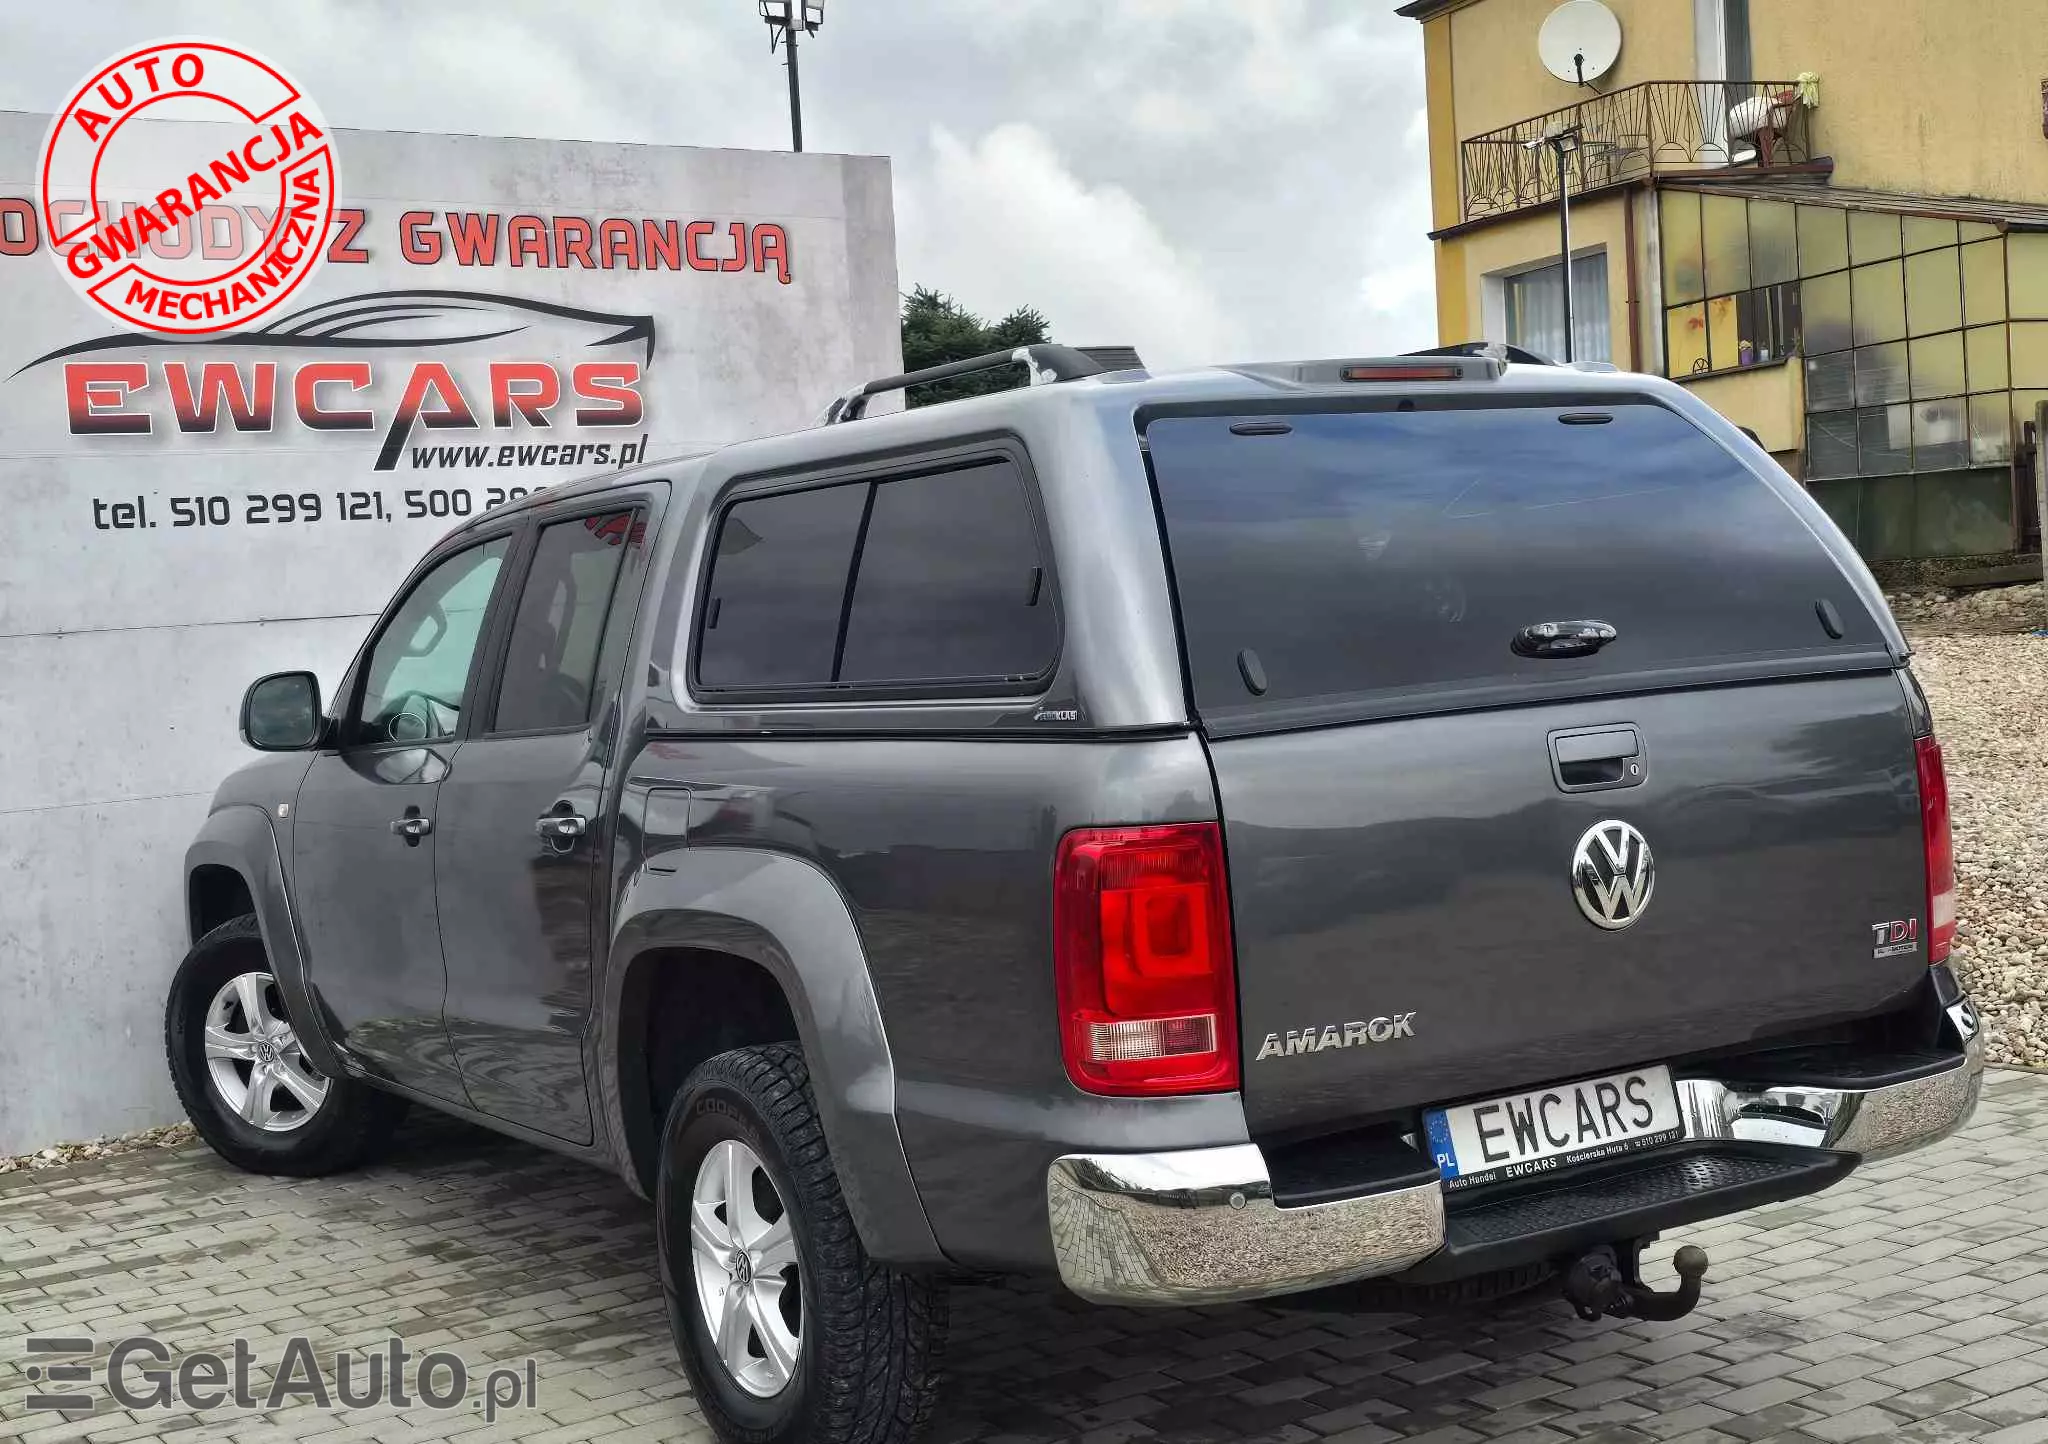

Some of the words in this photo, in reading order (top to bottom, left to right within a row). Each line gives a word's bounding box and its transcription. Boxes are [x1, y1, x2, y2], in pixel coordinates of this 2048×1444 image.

[327, 208, 369, 264] Z
[399, 211, 791, 285] GWARANCJĄ
[63, 361, 645, 472] EWCARS
[411, 434, 648, 470] www.ewcars.pl
[93, 495, 157, 530] tel.
[170, 495, 231, 528] 510
[246, 493, 322, 524] 299
[336, 491, 392, 523] 121,
[404, 488, 472, 518] 500
[1871, 918, 1918, 944] TDI
[1256, 1012, 1416, 1060] AMAROK
[1473, 1076, 1654, 1164] EWCARS
[1436, 1153, 1456, 1168] PL
[1449, 1178, 1468, 1189] Auto
[1505, 1157, 1557, 1178] EWCARS
